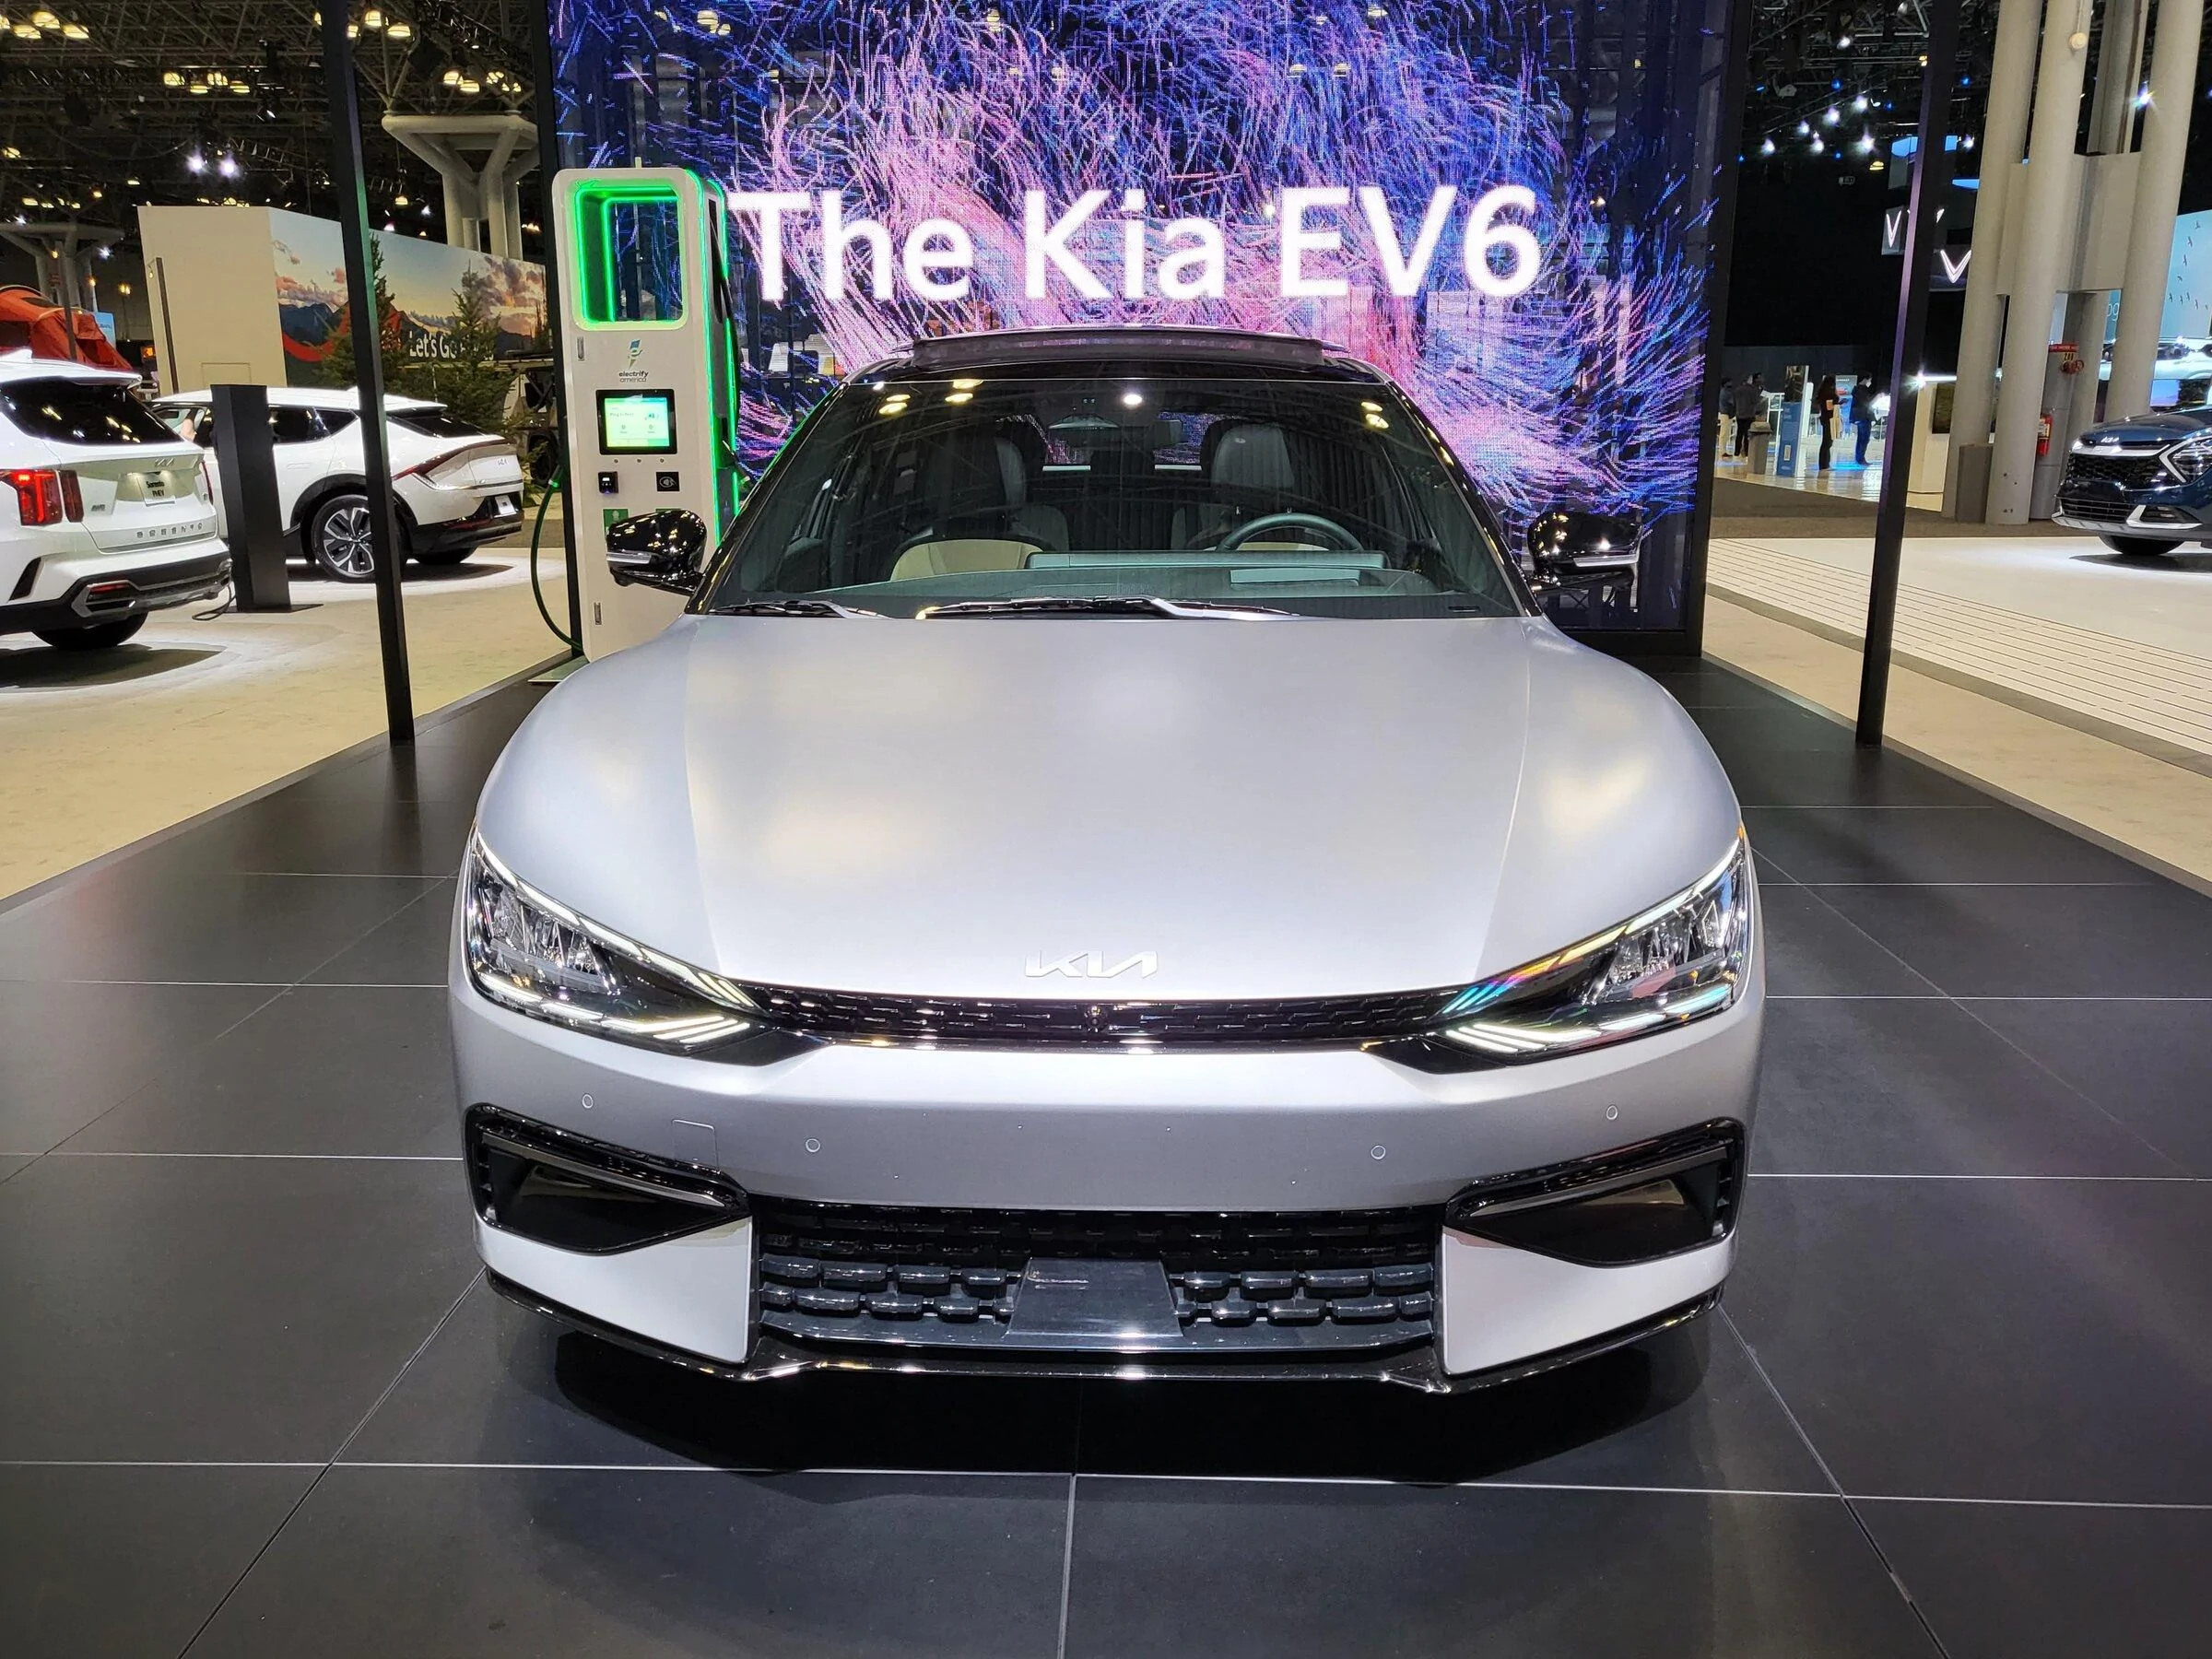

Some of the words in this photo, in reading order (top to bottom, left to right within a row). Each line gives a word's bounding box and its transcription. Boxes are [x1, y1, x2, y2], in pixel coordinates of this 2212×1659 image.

[727, 190, 973, 301] The
[1026, 189, 1226, 300] Kia
[1280, 185, 1543, 297] EV6
[409, 331, 438, 359] Let's
[1025, 949, 1158, 979] KIA
